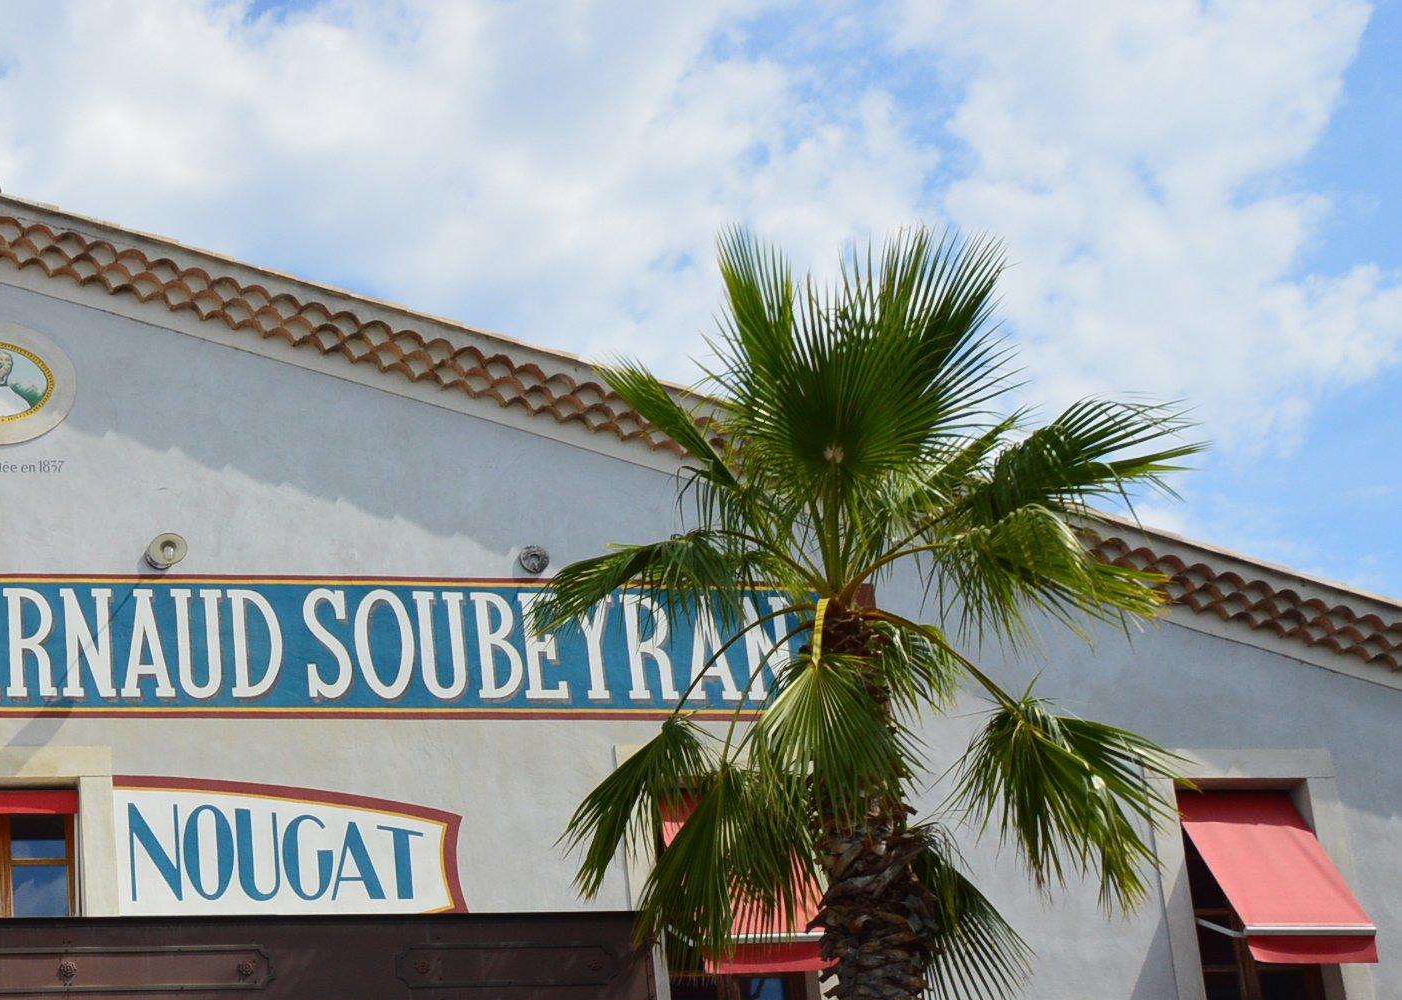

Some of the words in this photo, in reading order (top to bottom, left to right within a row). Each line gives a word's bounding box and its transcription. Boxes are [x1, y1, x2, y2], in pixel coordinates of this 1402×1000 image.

[21, 463, 36, 473] en
[303, 587, 794, 701] SOUBEYRAN
[127, 802, 425, 903] NOUGAT
